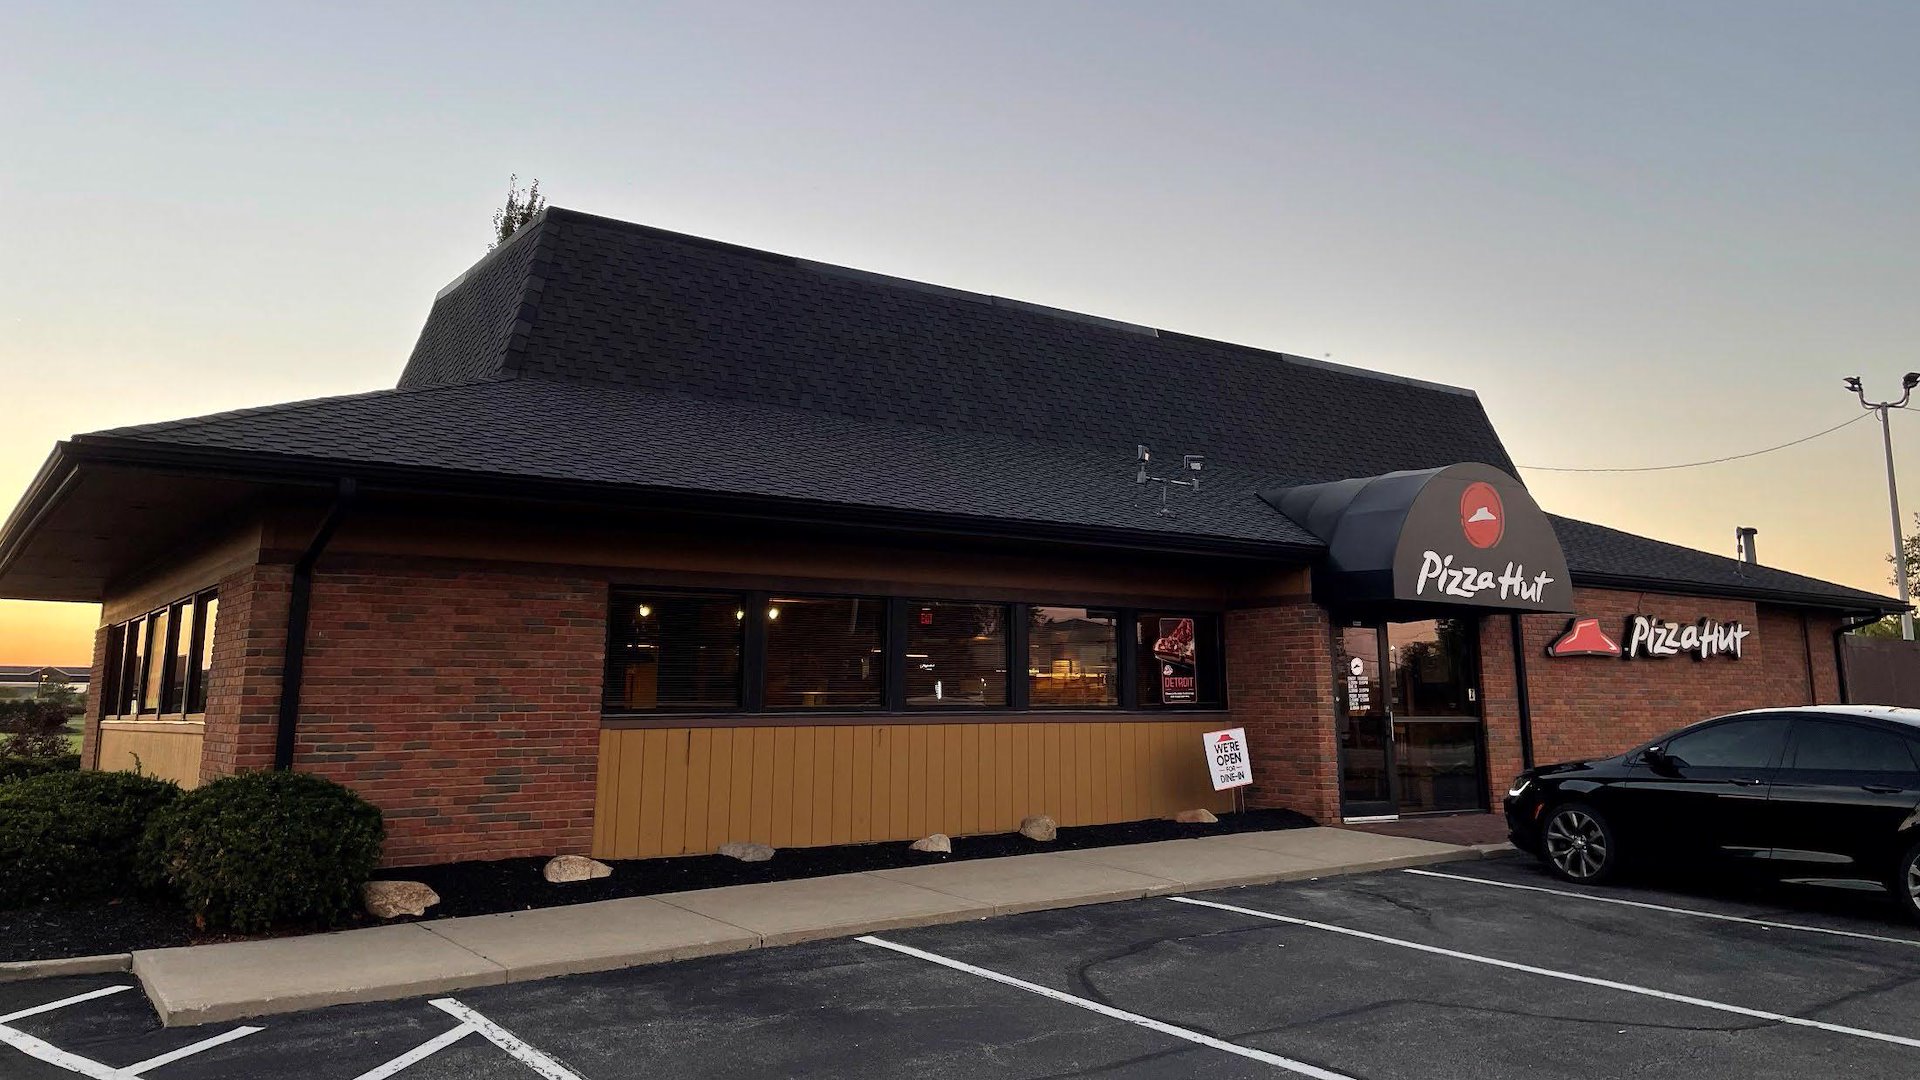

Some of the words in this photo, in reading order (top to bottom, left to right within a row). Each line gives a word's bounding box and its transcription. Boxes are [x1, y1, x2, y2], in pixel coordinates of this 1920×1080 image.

[1416, 550, 1496, 598] Pizza
[1498, 561, 1555, 603] Hut
[1630, 616, 1700, 658] Pizza
[1699, 620, 1750, 659] Hut
[1164, 677, 1194, 688] DETROIT
[1214, 741, 1240, 754] WE'RE
[1216, 752, 1242, 766] OPEN
[1220, 771, 1245, 783] DINE-IN
